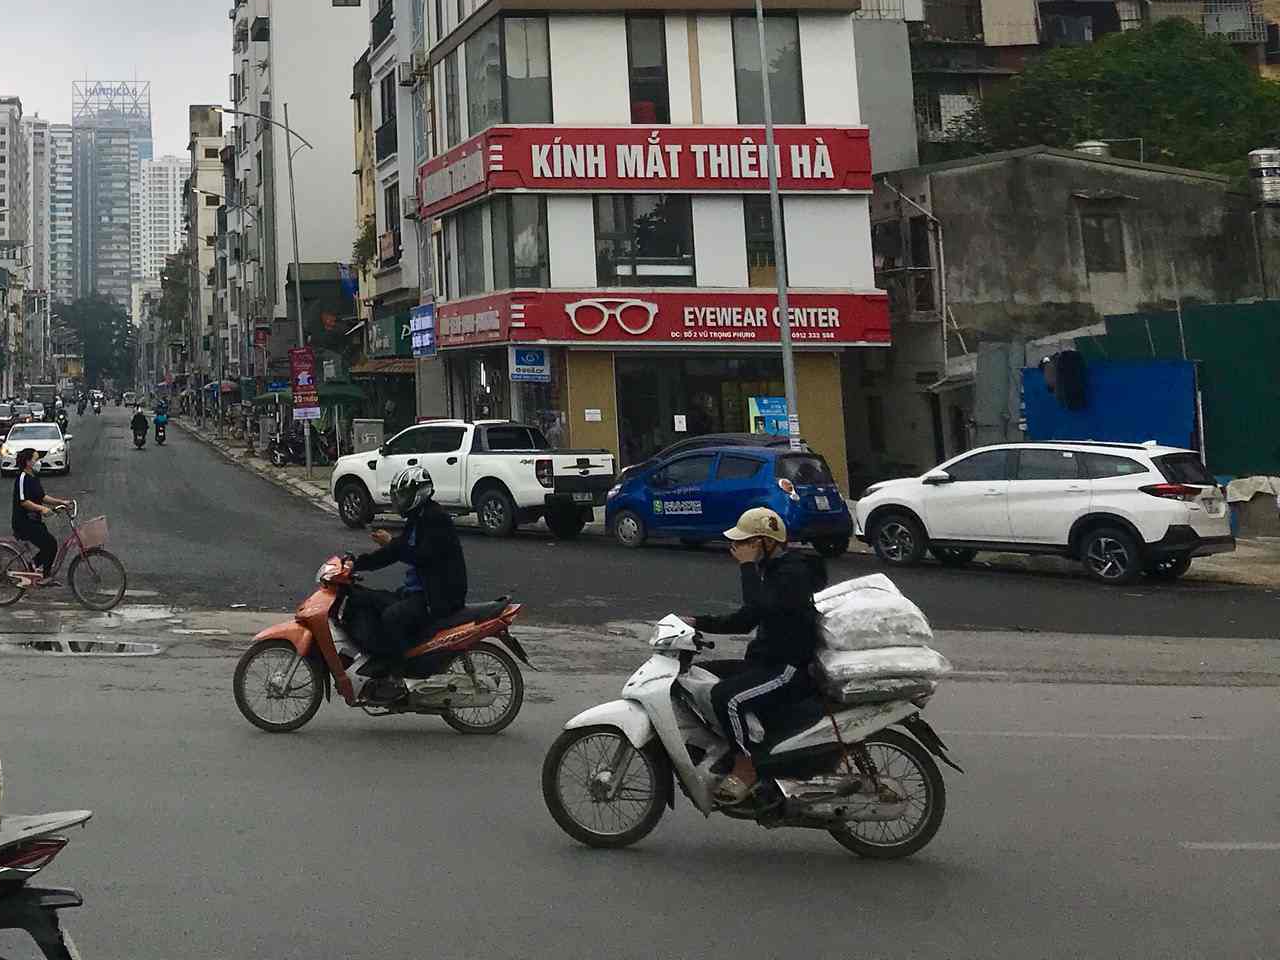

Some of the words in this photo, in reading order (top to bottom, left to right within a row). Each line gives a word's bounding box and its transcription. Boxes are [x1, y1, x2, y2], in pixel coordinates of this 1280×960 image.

[531, 137, 607, 178] KÍNH
[616, 131, 682, 179] MẮT
[690, 136, 782, 179] THIÊN
[789, 137, 835, 179] HÀ
[684, 306, 768, 328] EYEWEAR
[771, 306, 840, 328] CENTER
